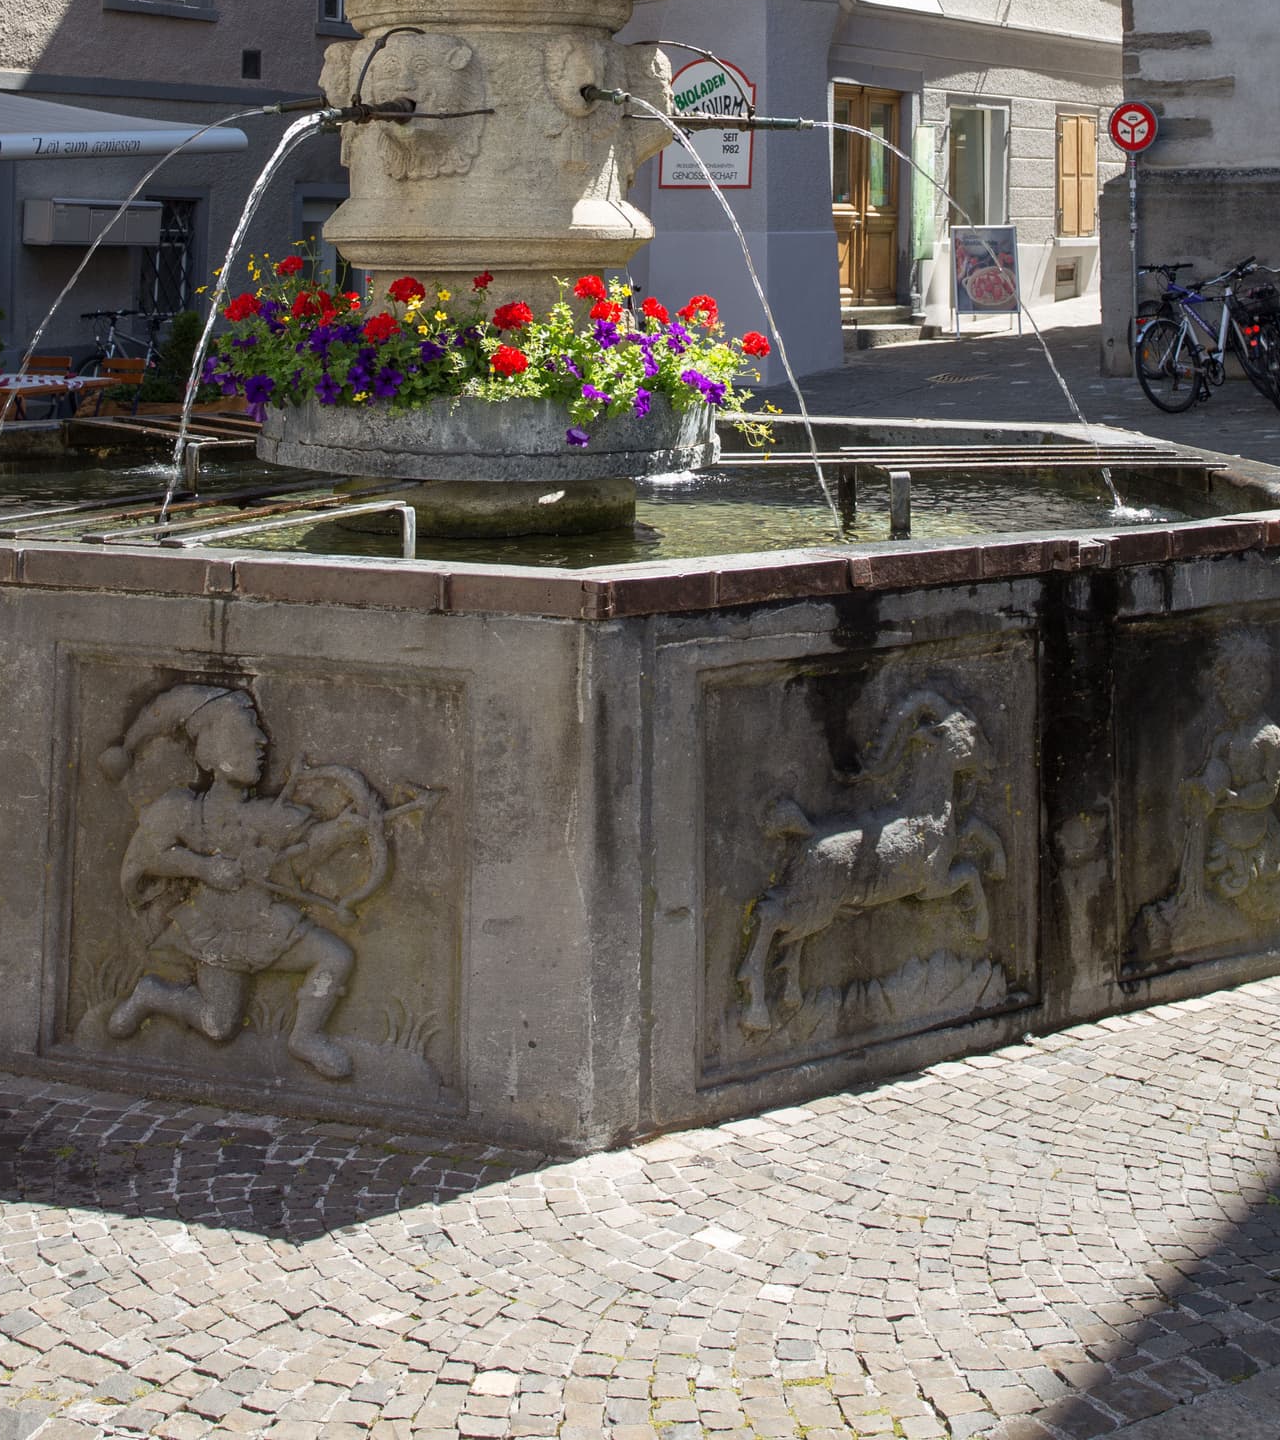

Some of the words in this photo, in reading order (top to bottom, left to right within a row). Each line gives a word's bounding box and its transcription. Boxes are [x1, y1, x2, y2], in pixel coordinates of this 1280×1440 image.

[673, 73, 727, 112] BIOLADEN
[723, 133, 739, 142] SEIT
[32, 137, 60, 155] Zeit
[64, 140, 88, 153] zum
[91, 137, 141, 154] geniessen
[722, 144, 740, 154] 1982
